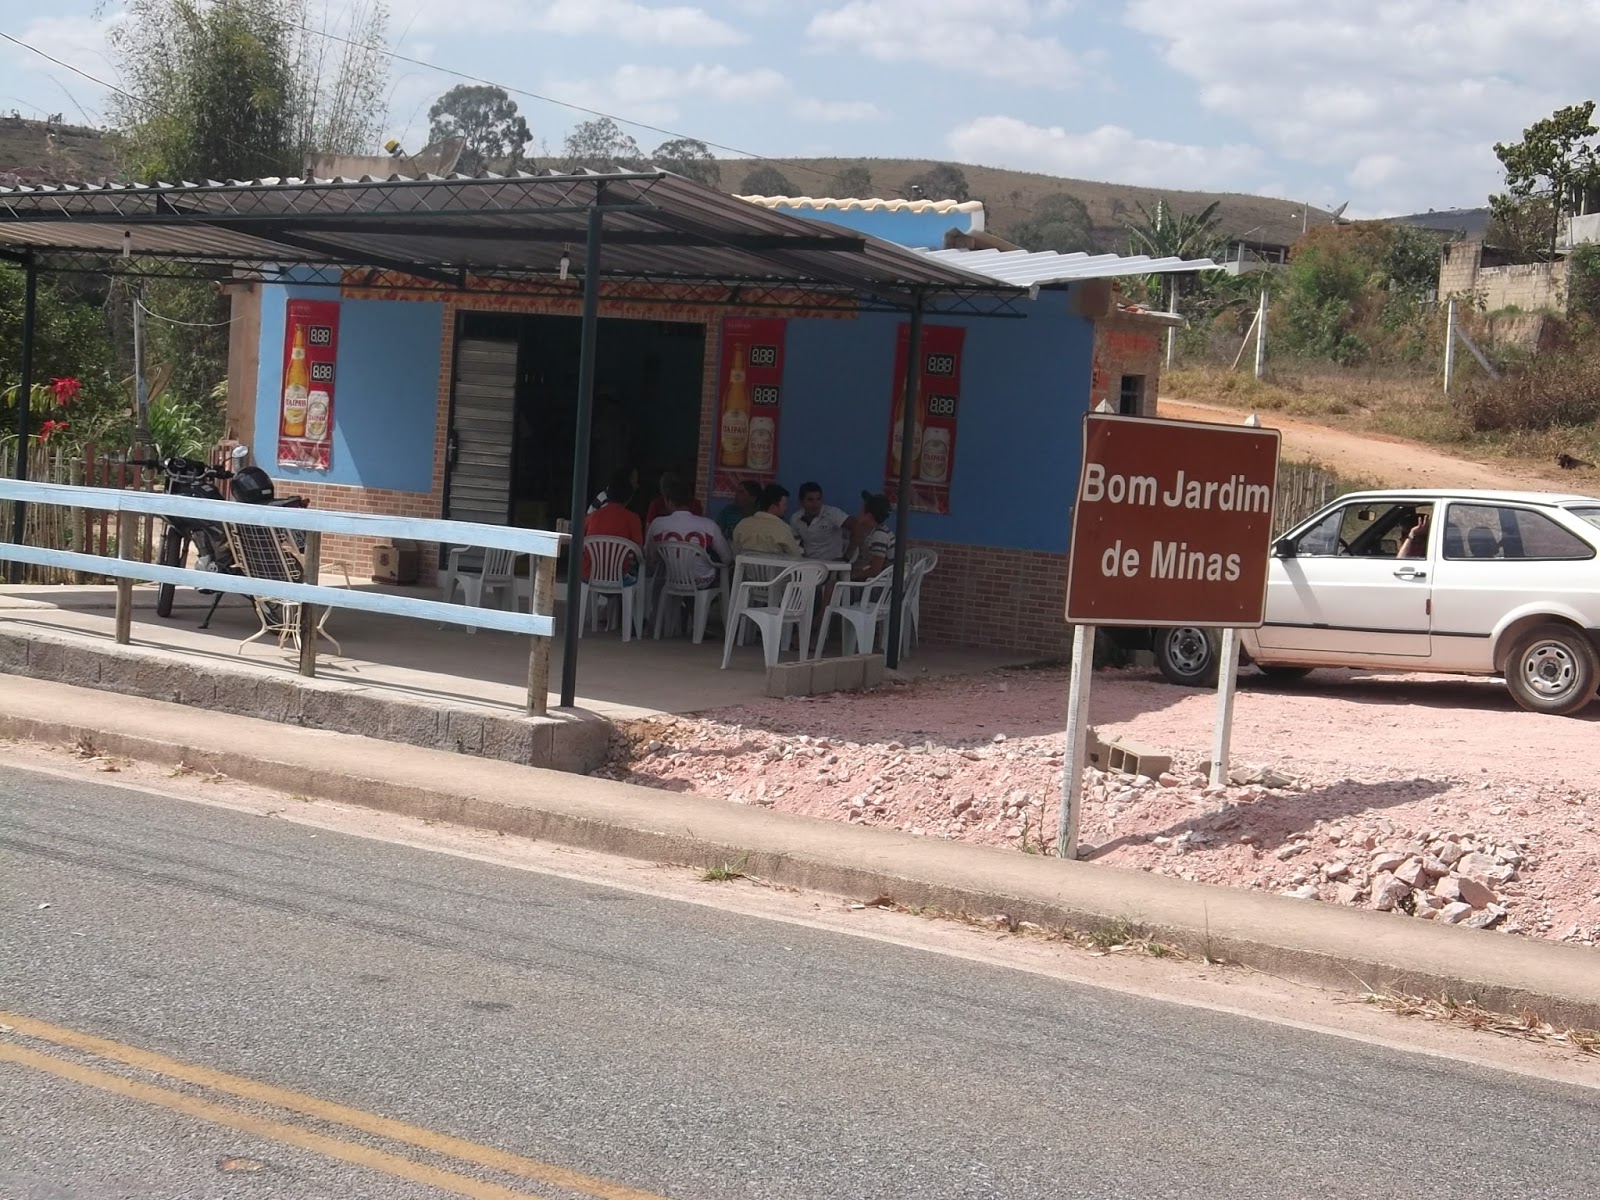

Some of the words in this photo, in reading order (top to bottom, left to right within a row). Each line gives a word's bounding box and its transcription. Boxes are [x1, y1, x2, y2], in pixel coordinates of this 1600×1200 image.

[1082, 463, 1158, 506] Bom
[1163, 470, 1270, 513] Jardim
[1101, 539, 1140, 578] de
[1150, 541, 1241, 581] Minas
